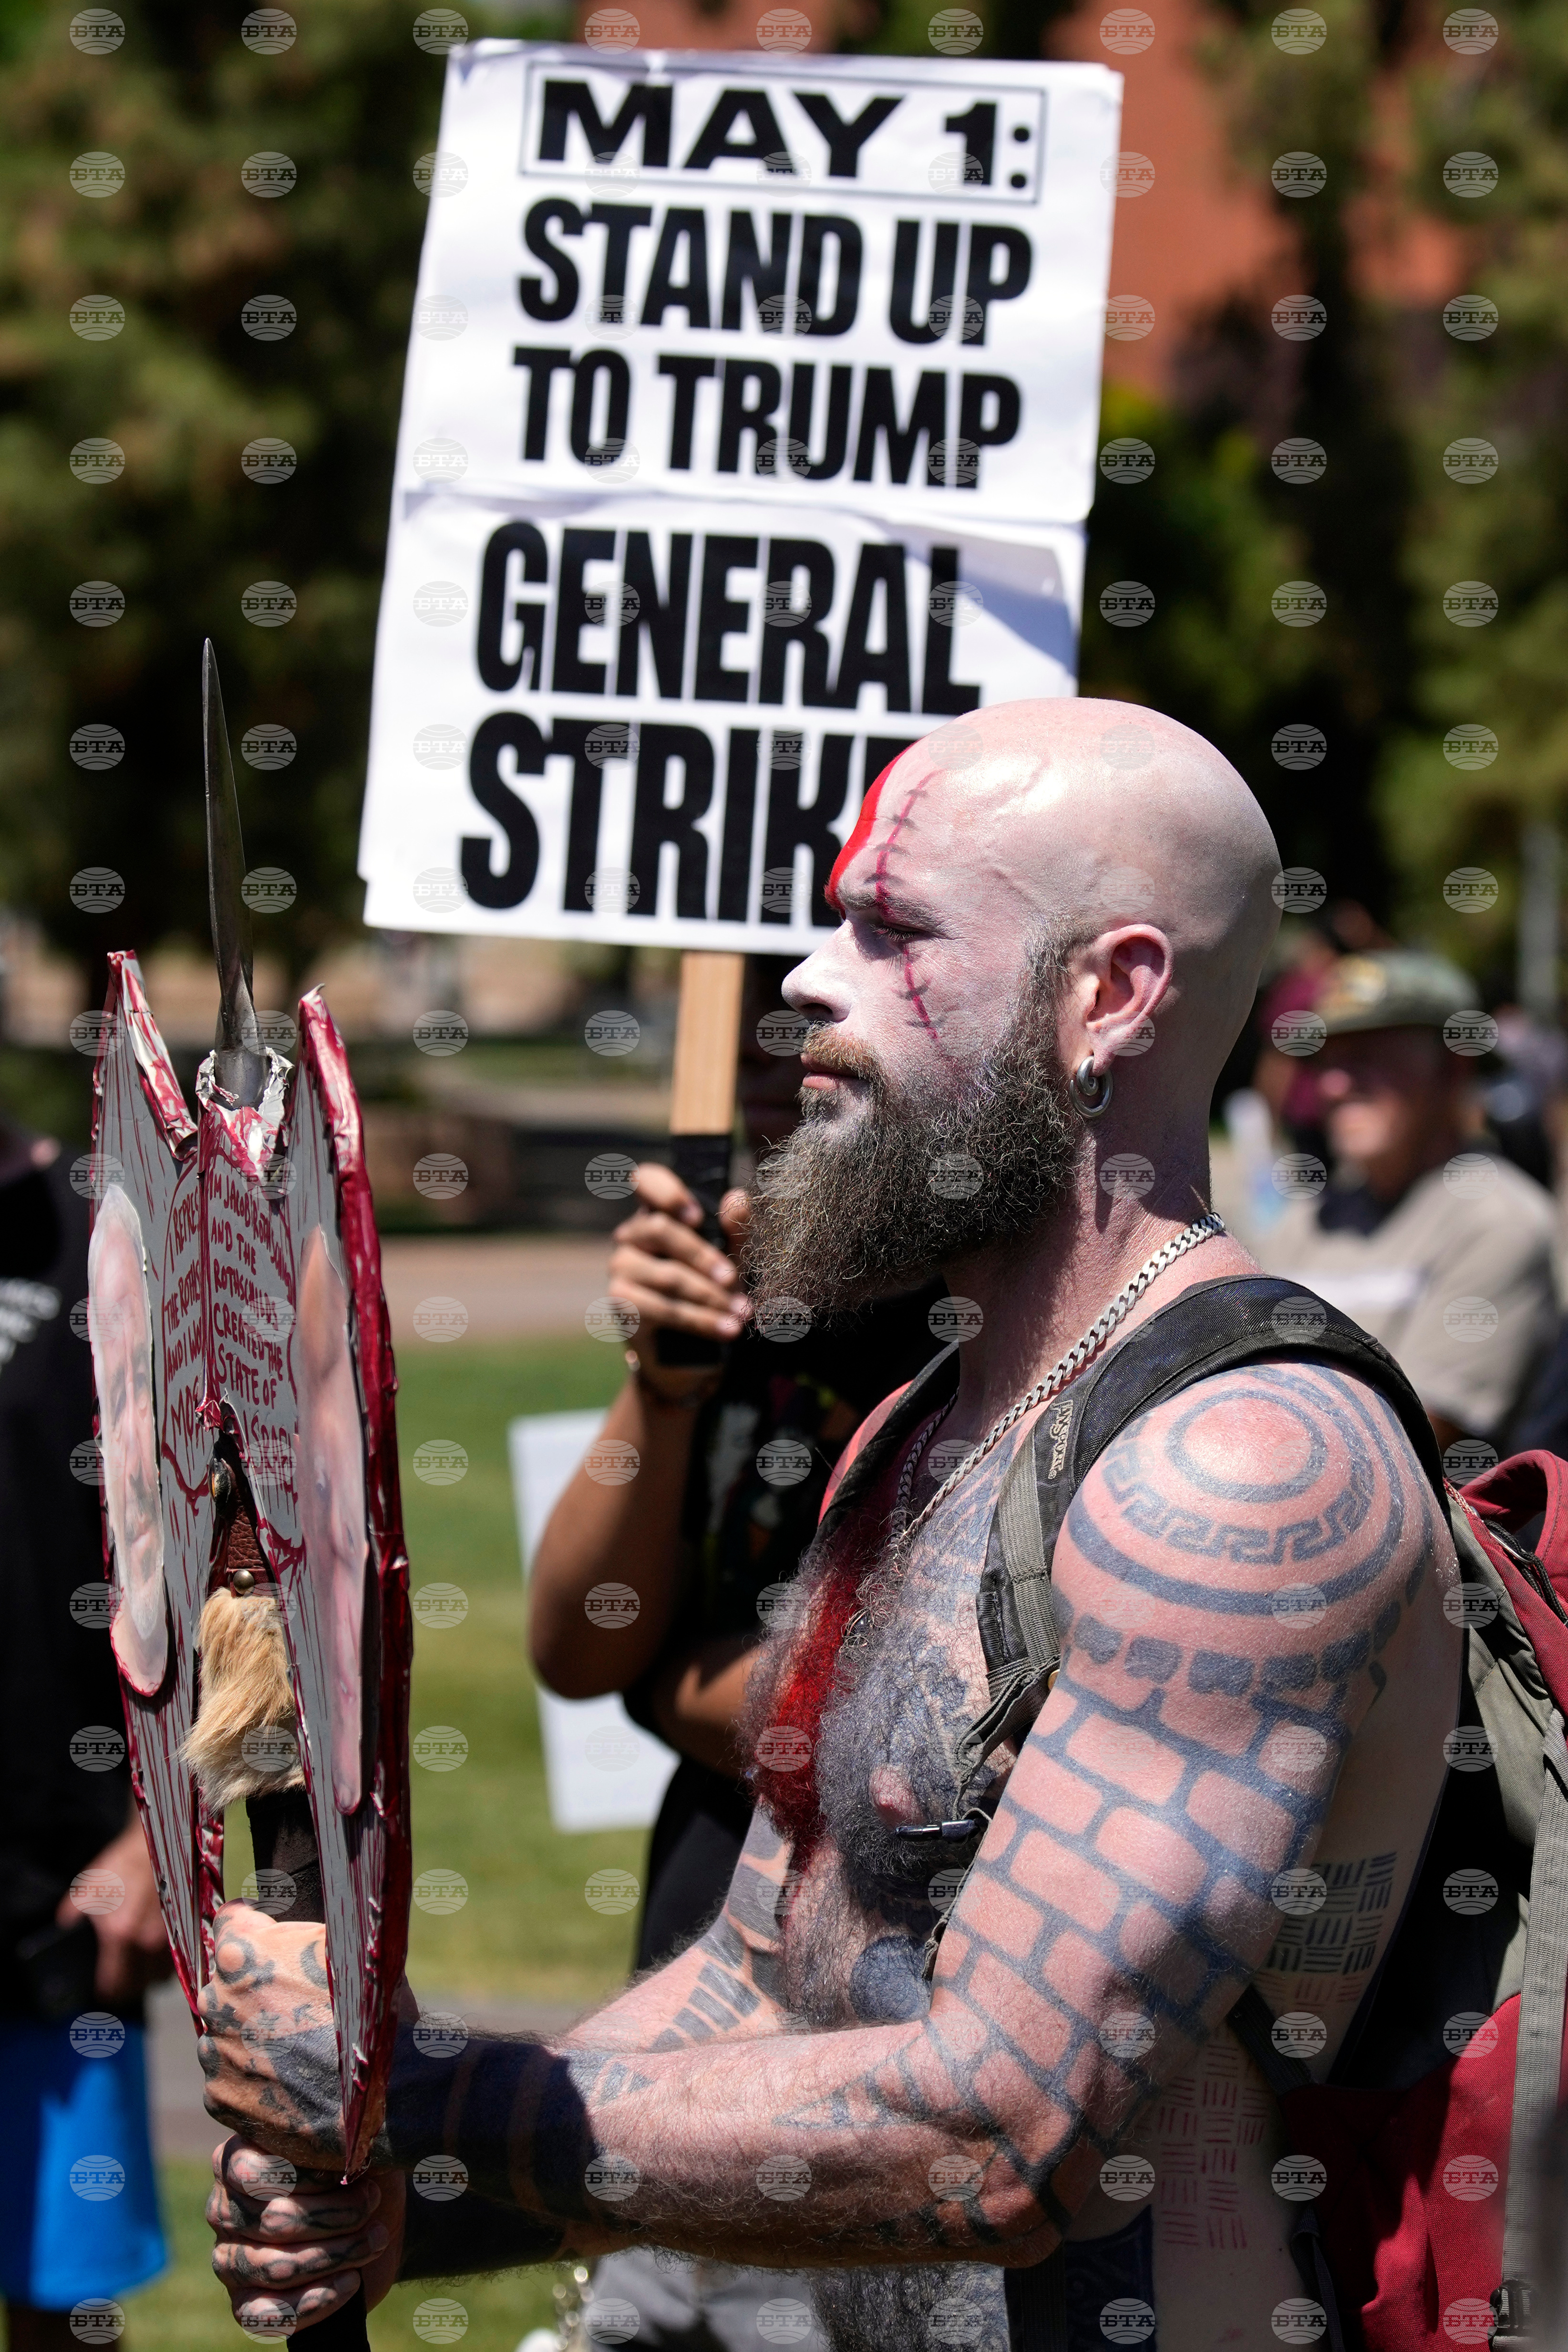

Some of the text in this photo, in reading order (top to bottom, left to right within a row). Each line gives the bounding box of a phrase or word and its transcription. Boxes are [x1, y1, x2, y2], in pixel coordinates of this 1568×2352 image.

[537, 79, 1032, 190] MAY 1:
[518, 197, 1033, 347] STAND UP
[513, 345, 1021, 490] TO TRUMP
[475, 520, 981, 718] GENERAL
[459, 710, 923, 930] STRIK
[211, 1217, 256, 1275] AND THE
[164, 1292, 180, 1335] THE
[264, 1339, 283, 1381] THE
[216, 1343, 277, 1410] STATE OF
